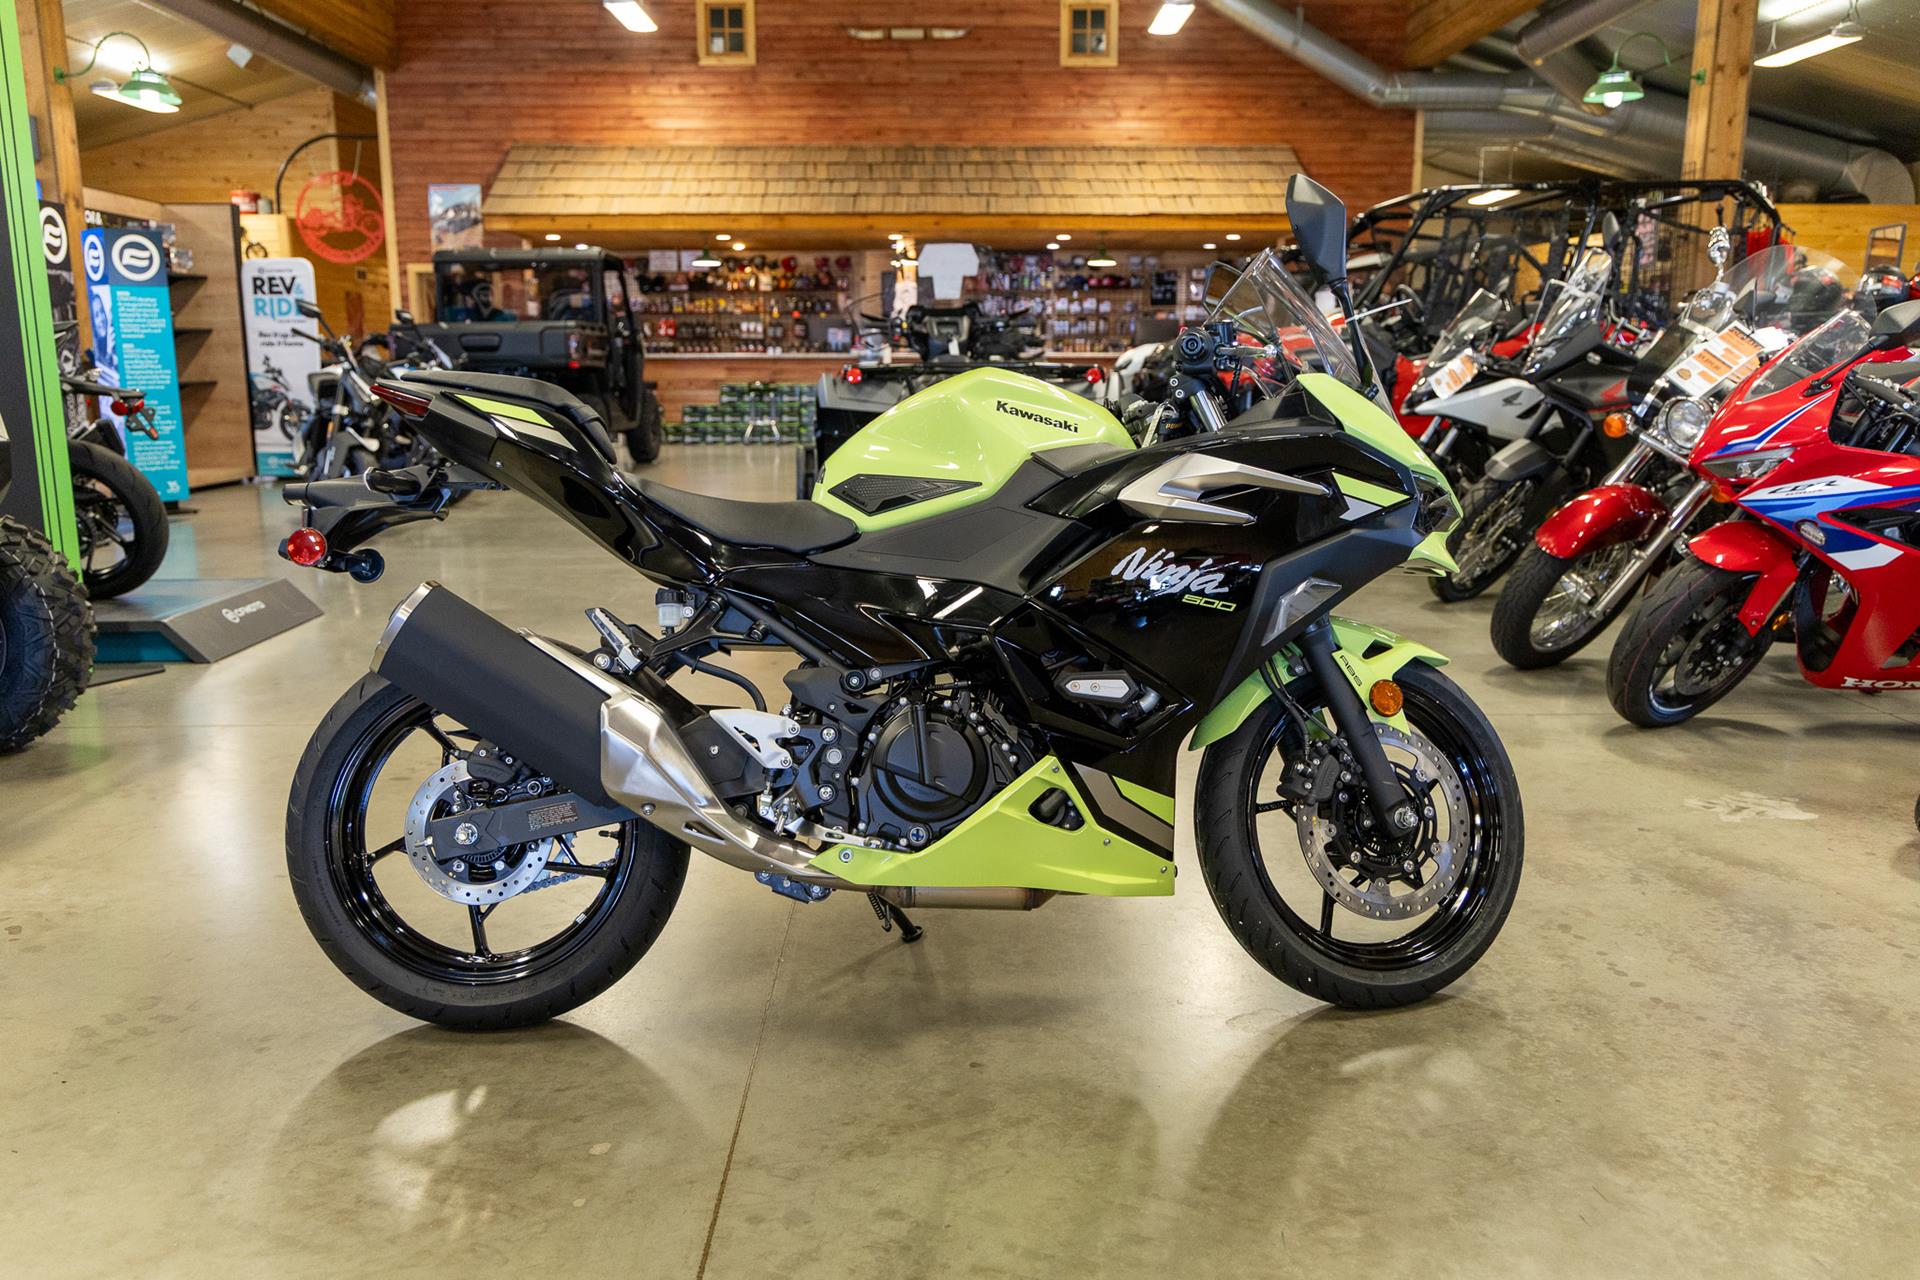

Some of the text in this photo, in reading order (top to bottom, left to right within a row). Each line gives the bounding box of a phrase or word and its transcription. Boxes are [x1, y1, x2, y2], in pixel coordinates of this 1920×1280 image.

[252, 276, 296, 295] REV
[996, 400, 1078, 433] Kawasaki
[1111, 547, 1239, 599] Ninja
[1182, 594, 1236, 611] 500
[1340, 655, 1362, 686] ABS
